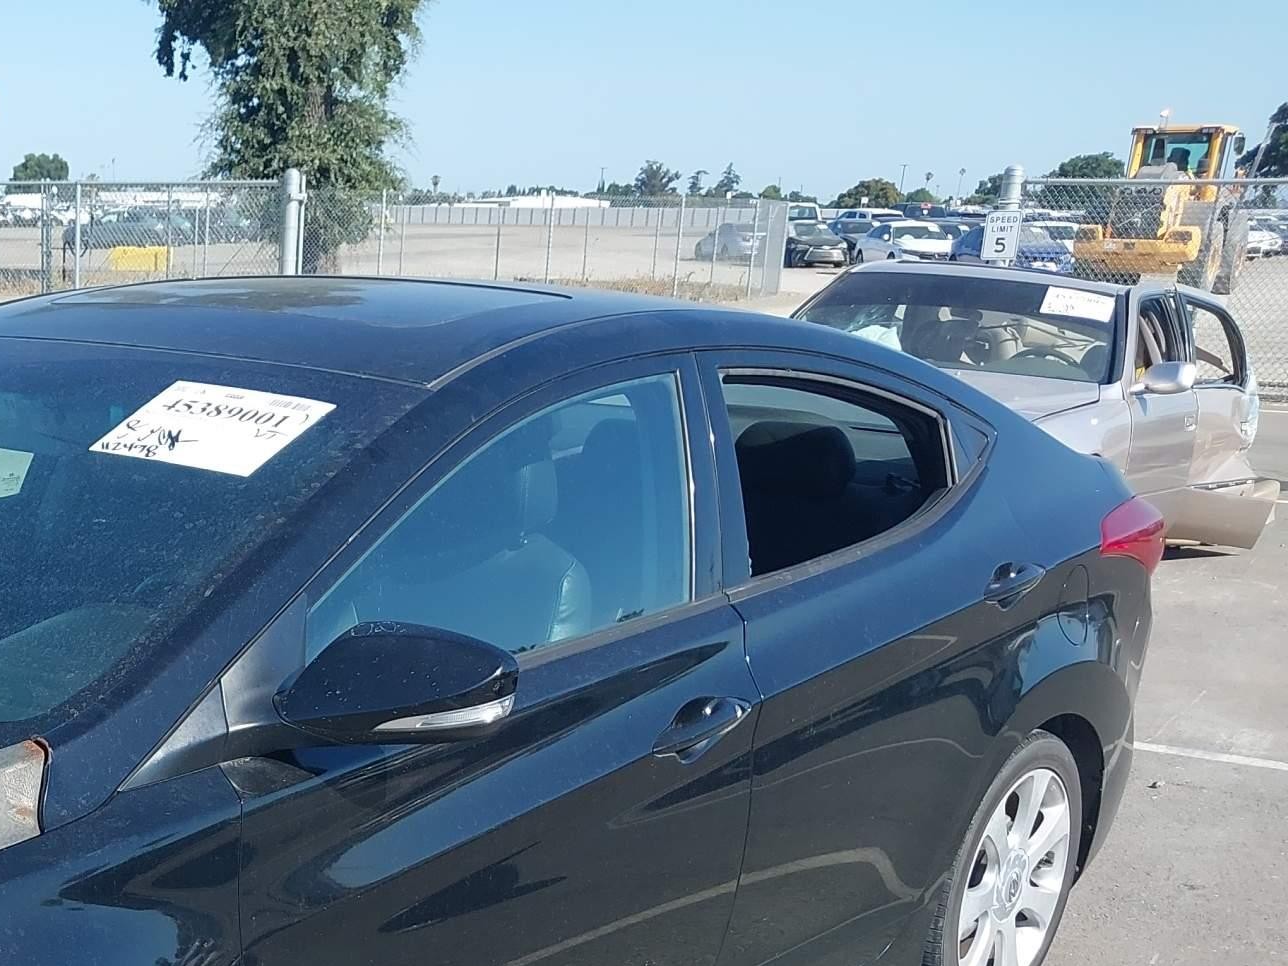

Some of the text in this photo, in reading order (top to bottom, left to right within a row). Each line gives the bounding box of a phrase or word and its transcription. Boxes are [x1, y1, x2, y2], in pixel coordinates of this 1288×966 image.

[991, 225, 1014, 233] LIMIT
[993, 237, 1006, 253] 5
[162, 398, 291, 428] 45389001
